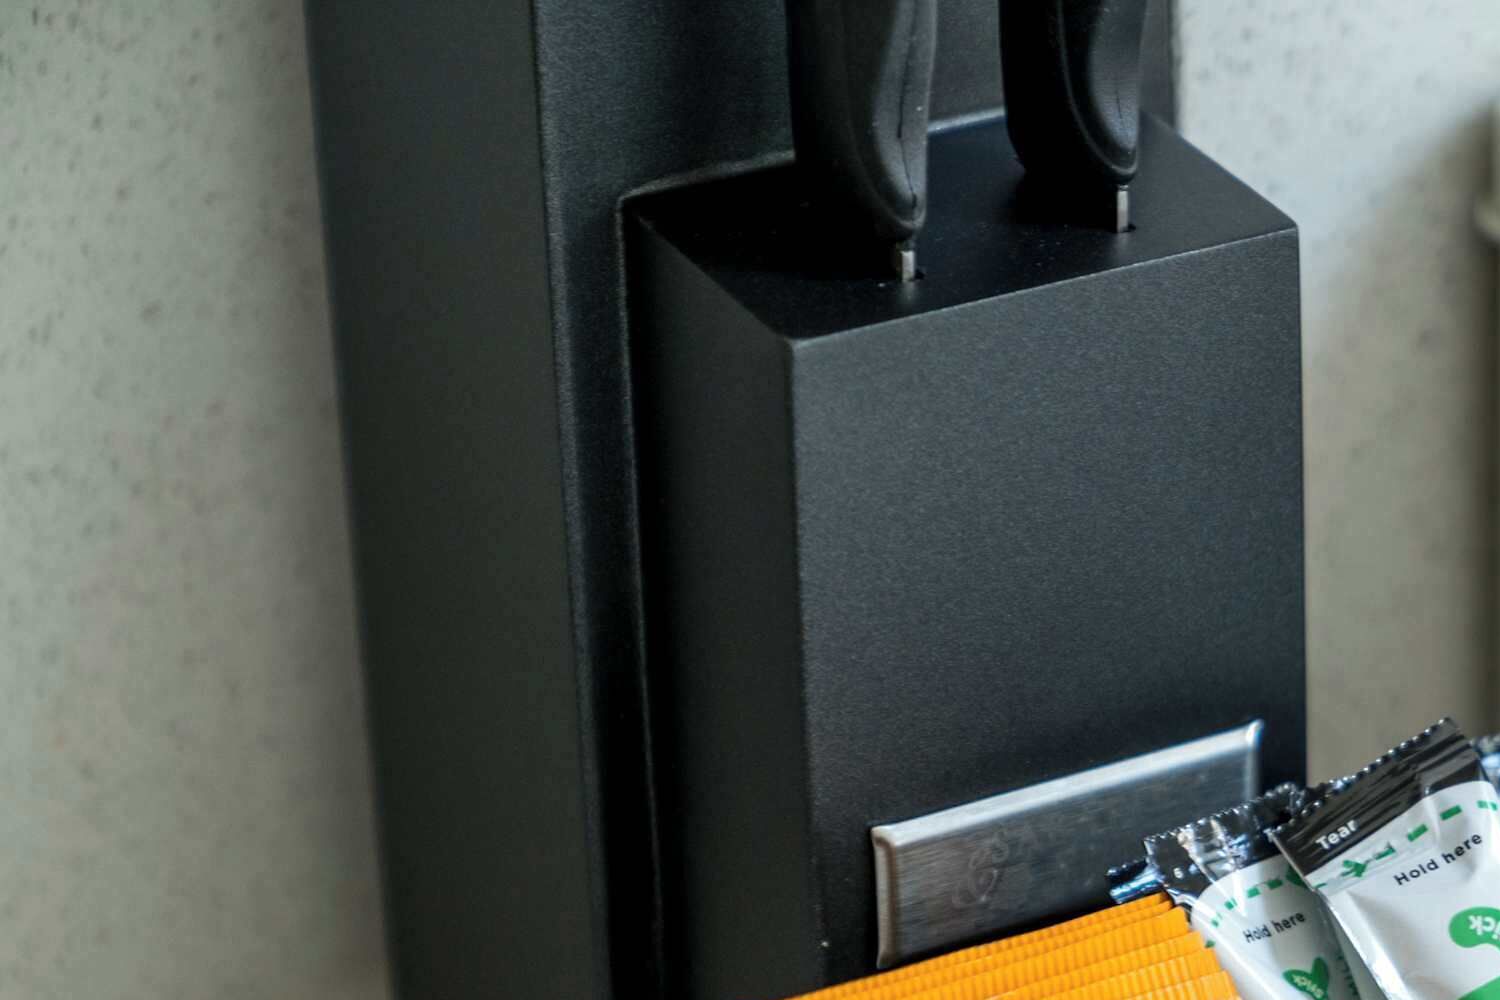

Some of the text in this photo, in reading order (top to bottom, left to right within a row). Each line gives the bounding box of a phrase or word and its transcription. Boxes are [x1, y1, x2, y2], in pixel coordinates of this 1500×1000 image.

[1314, 818, 1358, 852] Tear
[1393, 831, 1484, 887] Hold here
[1243, 911, 1306, 944] Hold here
